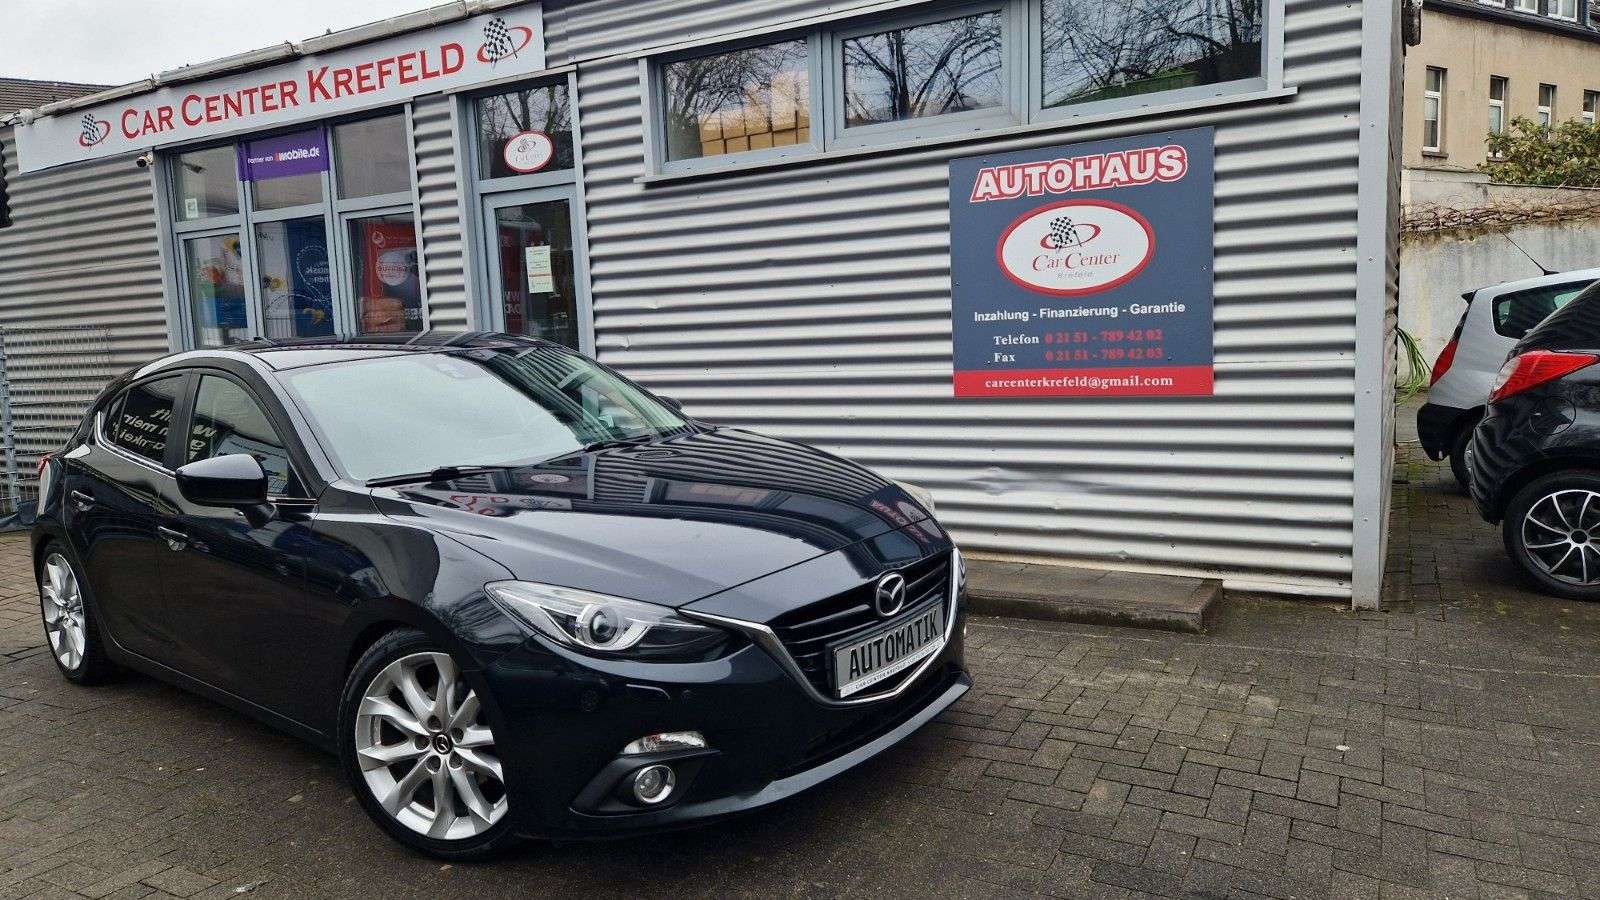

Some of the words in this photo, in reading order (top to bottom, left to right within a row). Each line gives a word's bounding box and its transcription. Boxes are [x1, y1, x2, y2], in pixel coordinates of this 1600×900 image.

[121, 105, 175, 140] CAR
[181, 79, 299, 127] CENTER
[306, 42, 465, 103] KREFELD
[970, 145, 1188, 202] AUTOHAUS
[974, 309, 1029, 322] Inzahlung
[1040, 306, 1119, 318] Finanzierung
[1129, 301, 1186, 315] Garantie
[993, 333, 1040, 345] Telefon
[993, 352, 1016, 363] Fax
[984, 375, 1174, 390] carcenterkrefeld@gmail.com
[848, 608, 938, 680] AUTOMATIK
